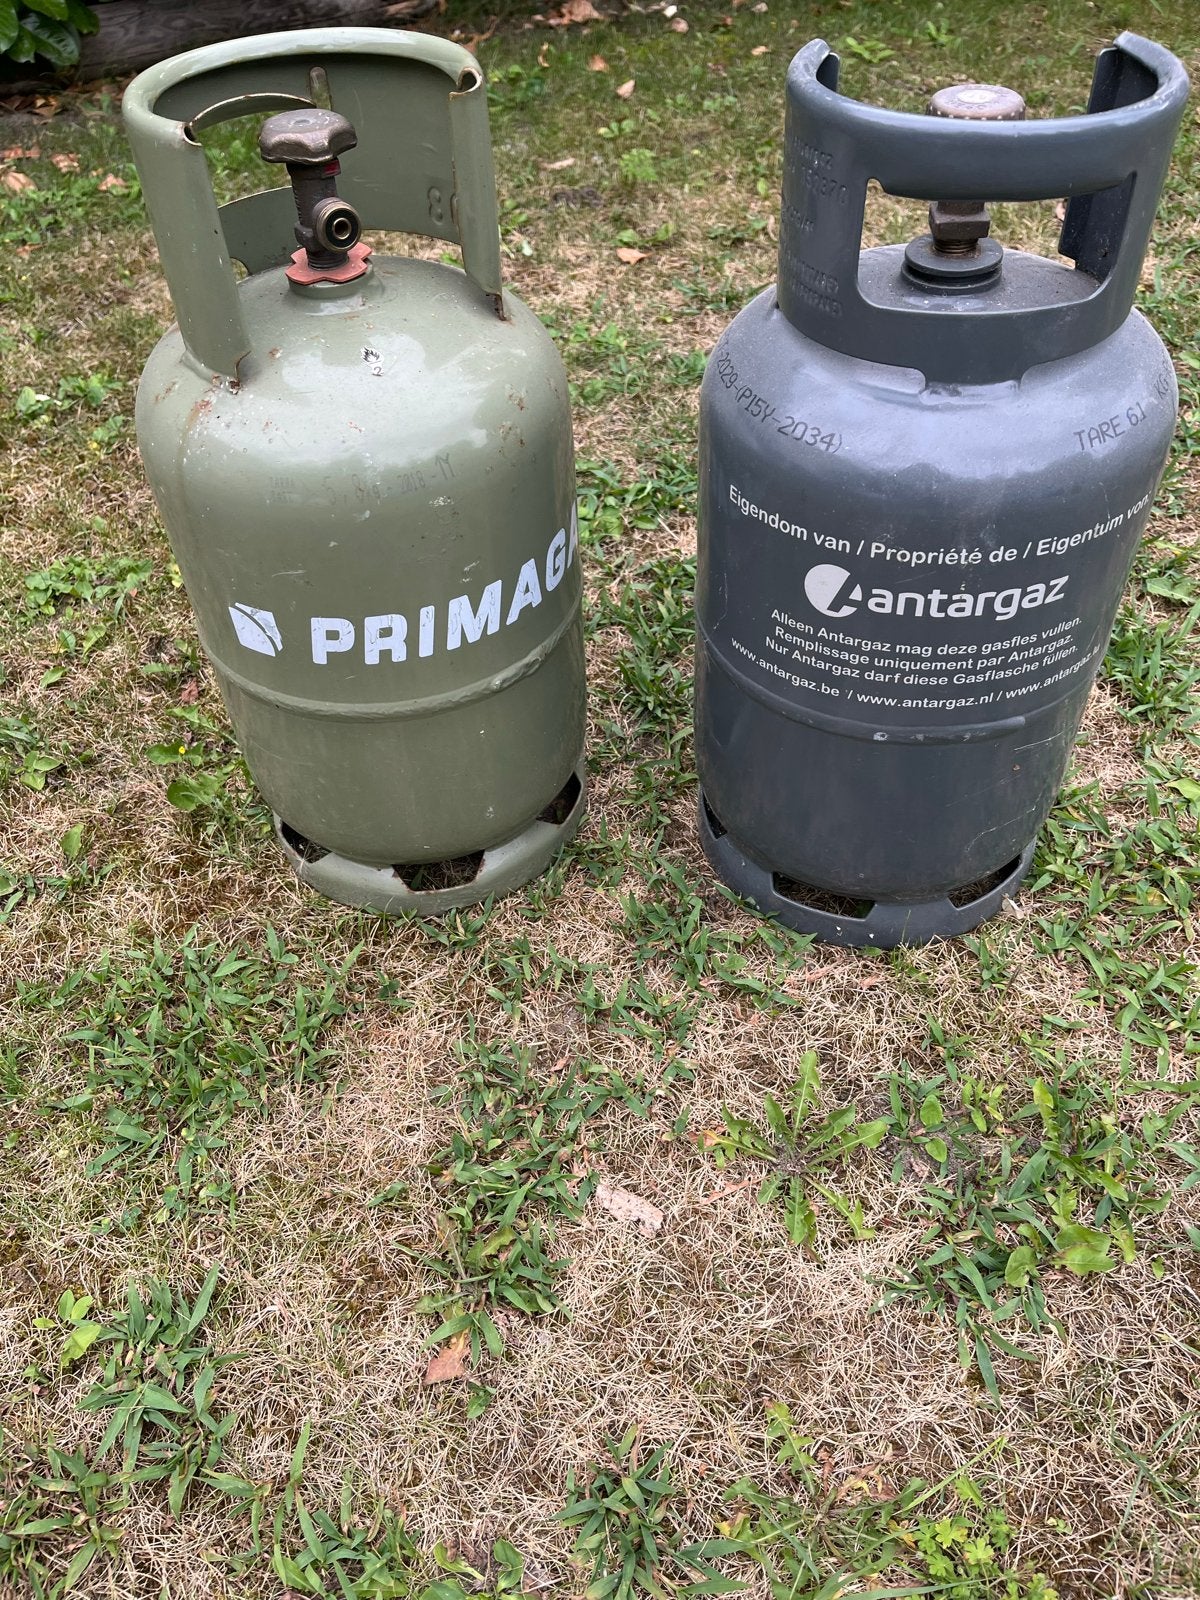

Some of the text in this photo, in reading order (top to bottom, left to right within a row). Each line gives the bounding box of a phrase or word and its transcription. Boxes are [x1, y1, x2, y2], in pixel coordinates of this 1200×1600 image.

[1073, 414, 1126, 451] TARE
[729, 484, 807, 541] Eigendom
[813, 531, 850, 553] van
[856, 539, 865, 555] /
[870, 541, 983, 567] Propriété
[988, 546, 1018, 563] de
[1022, 541, 1033, 559] /
[1036, 514, 1124, 556] Eigentum
[867, 575, 1070, 621] antargaz
[771, 608, 1083, 658] Alleen Antargaz mag deze gasfles vullen.
[775, 626, 1074, 672] Remplissage uniquement par Antargaz.
[731, 637, 841, 697] www.antargaz.be
[856, 692, 994, 710] www.antargaz.nl
[765, 636, 1079, 686] Nur Antargaz darf diese Gasflasche füllen.
